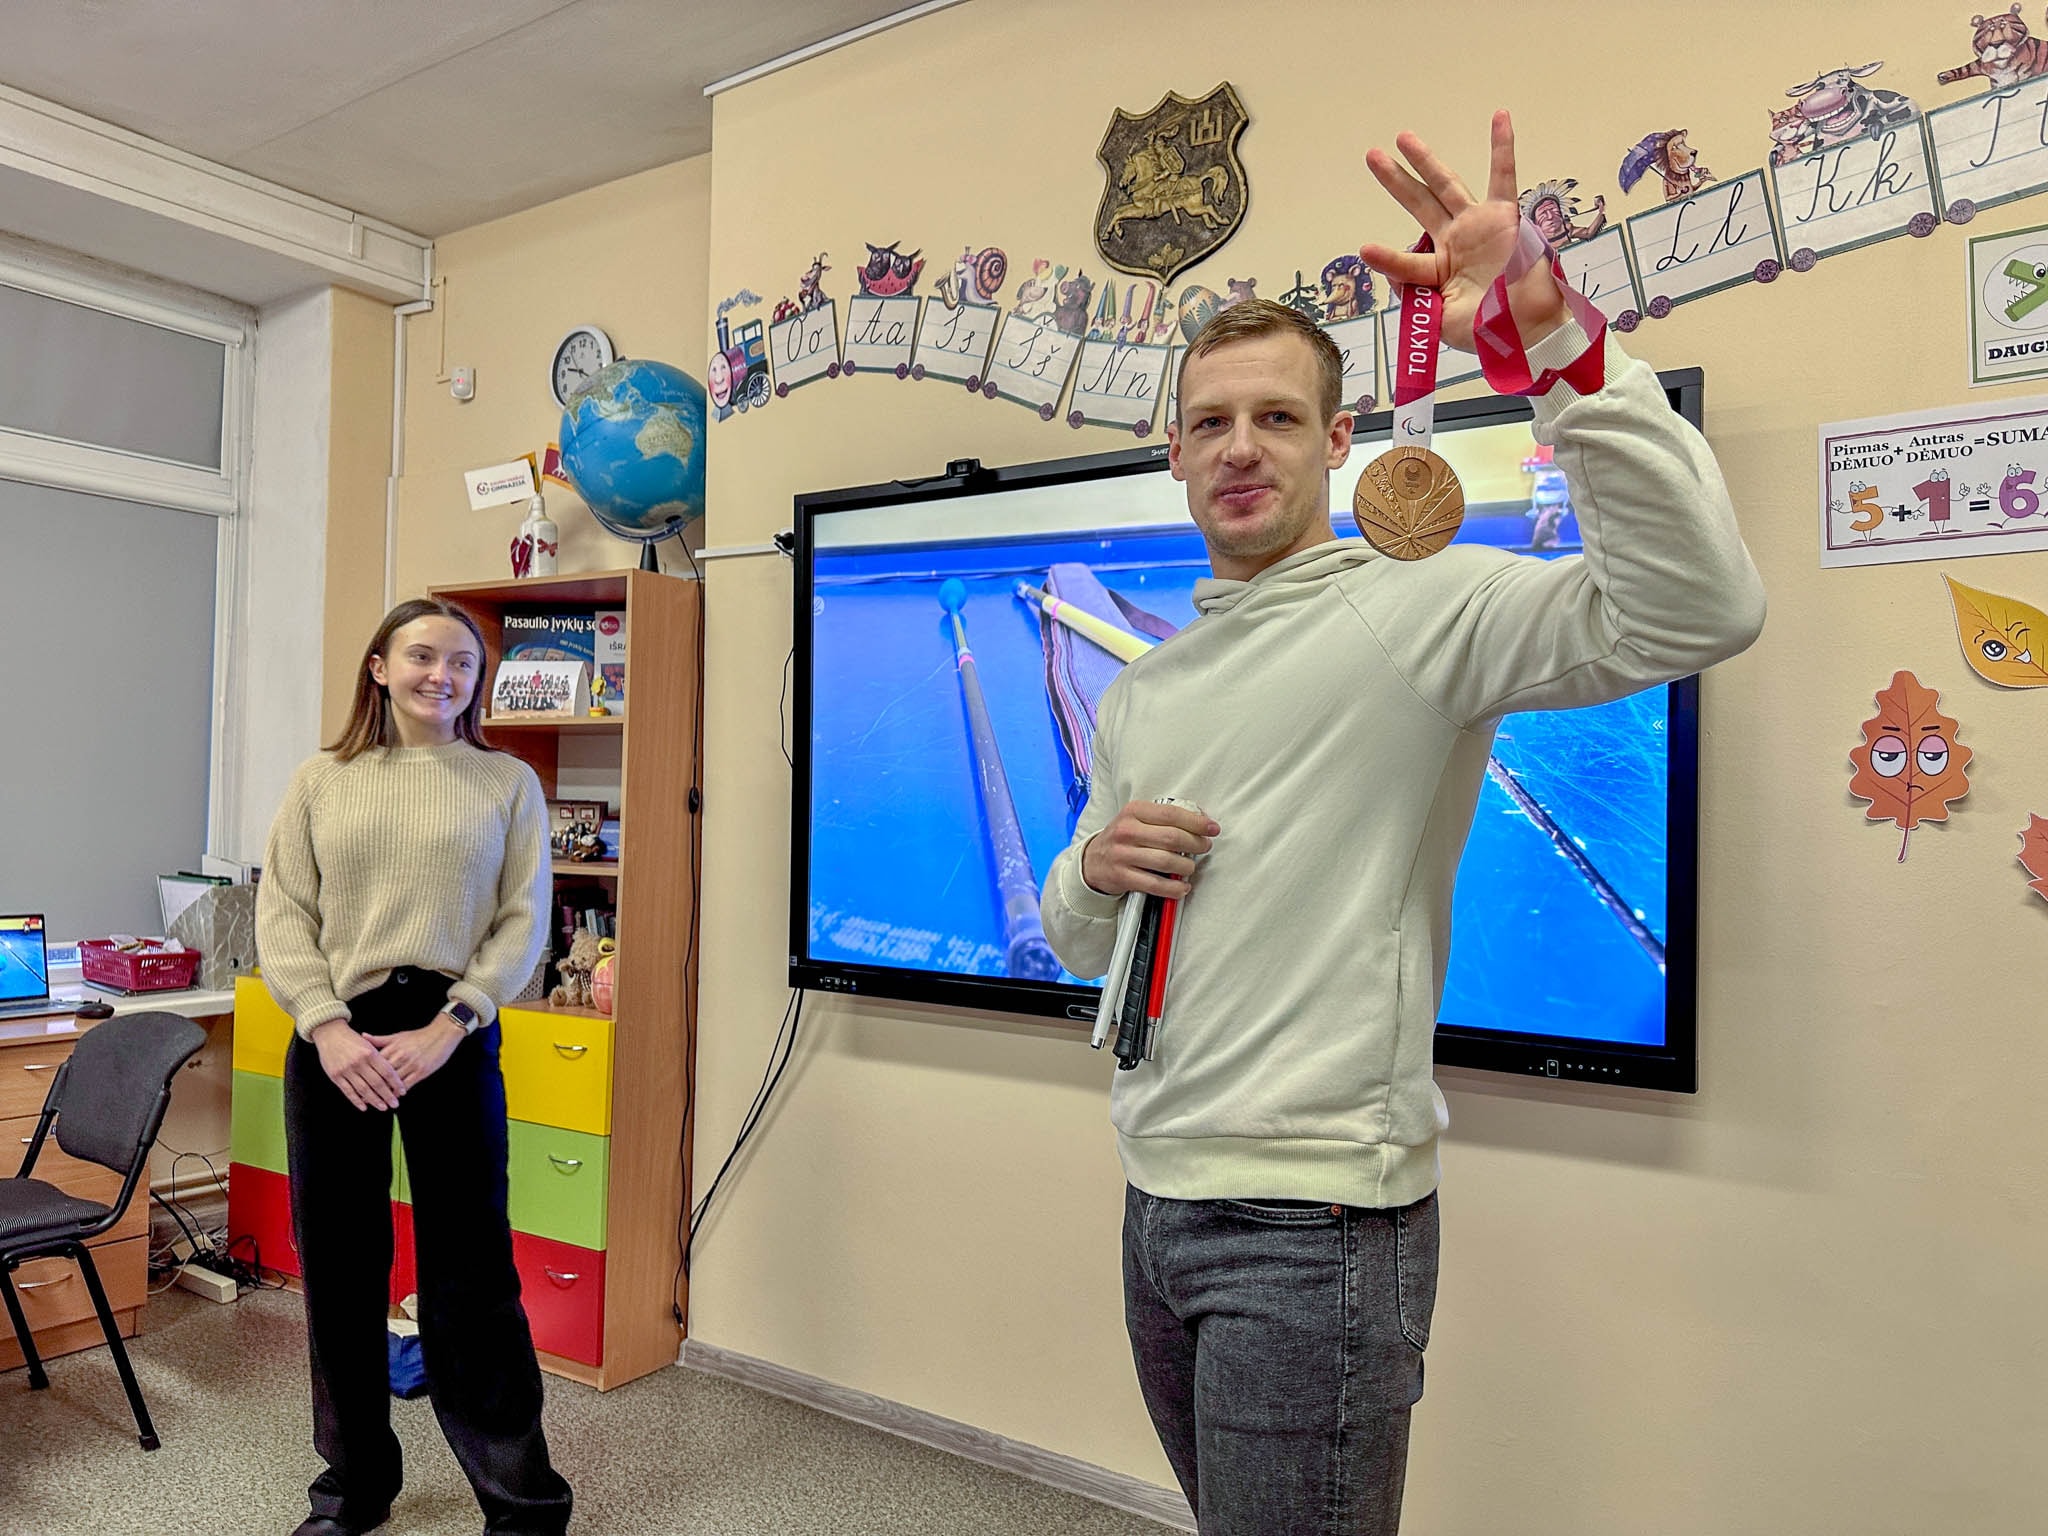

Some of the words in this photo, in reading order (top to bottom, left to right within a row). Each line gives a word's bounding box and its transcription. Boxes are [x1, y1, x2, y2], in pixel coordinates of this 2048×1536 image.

[1408, 313, 1430, 375] TOKYO
[1830, 454, 1894, 472] DĖMUO
[1906, 445, 1973, 464] DĖMUO
[1833, 442, 1889, 457] Pirmas
[1909, 433, 1964, 448] Antras
[1848, 484, 1885, 532] 5
[1912, 477, 1951, 522] 1
[1998, 468, 2040, 519] 6
[504, 615, 550, 630] Pasaulio
